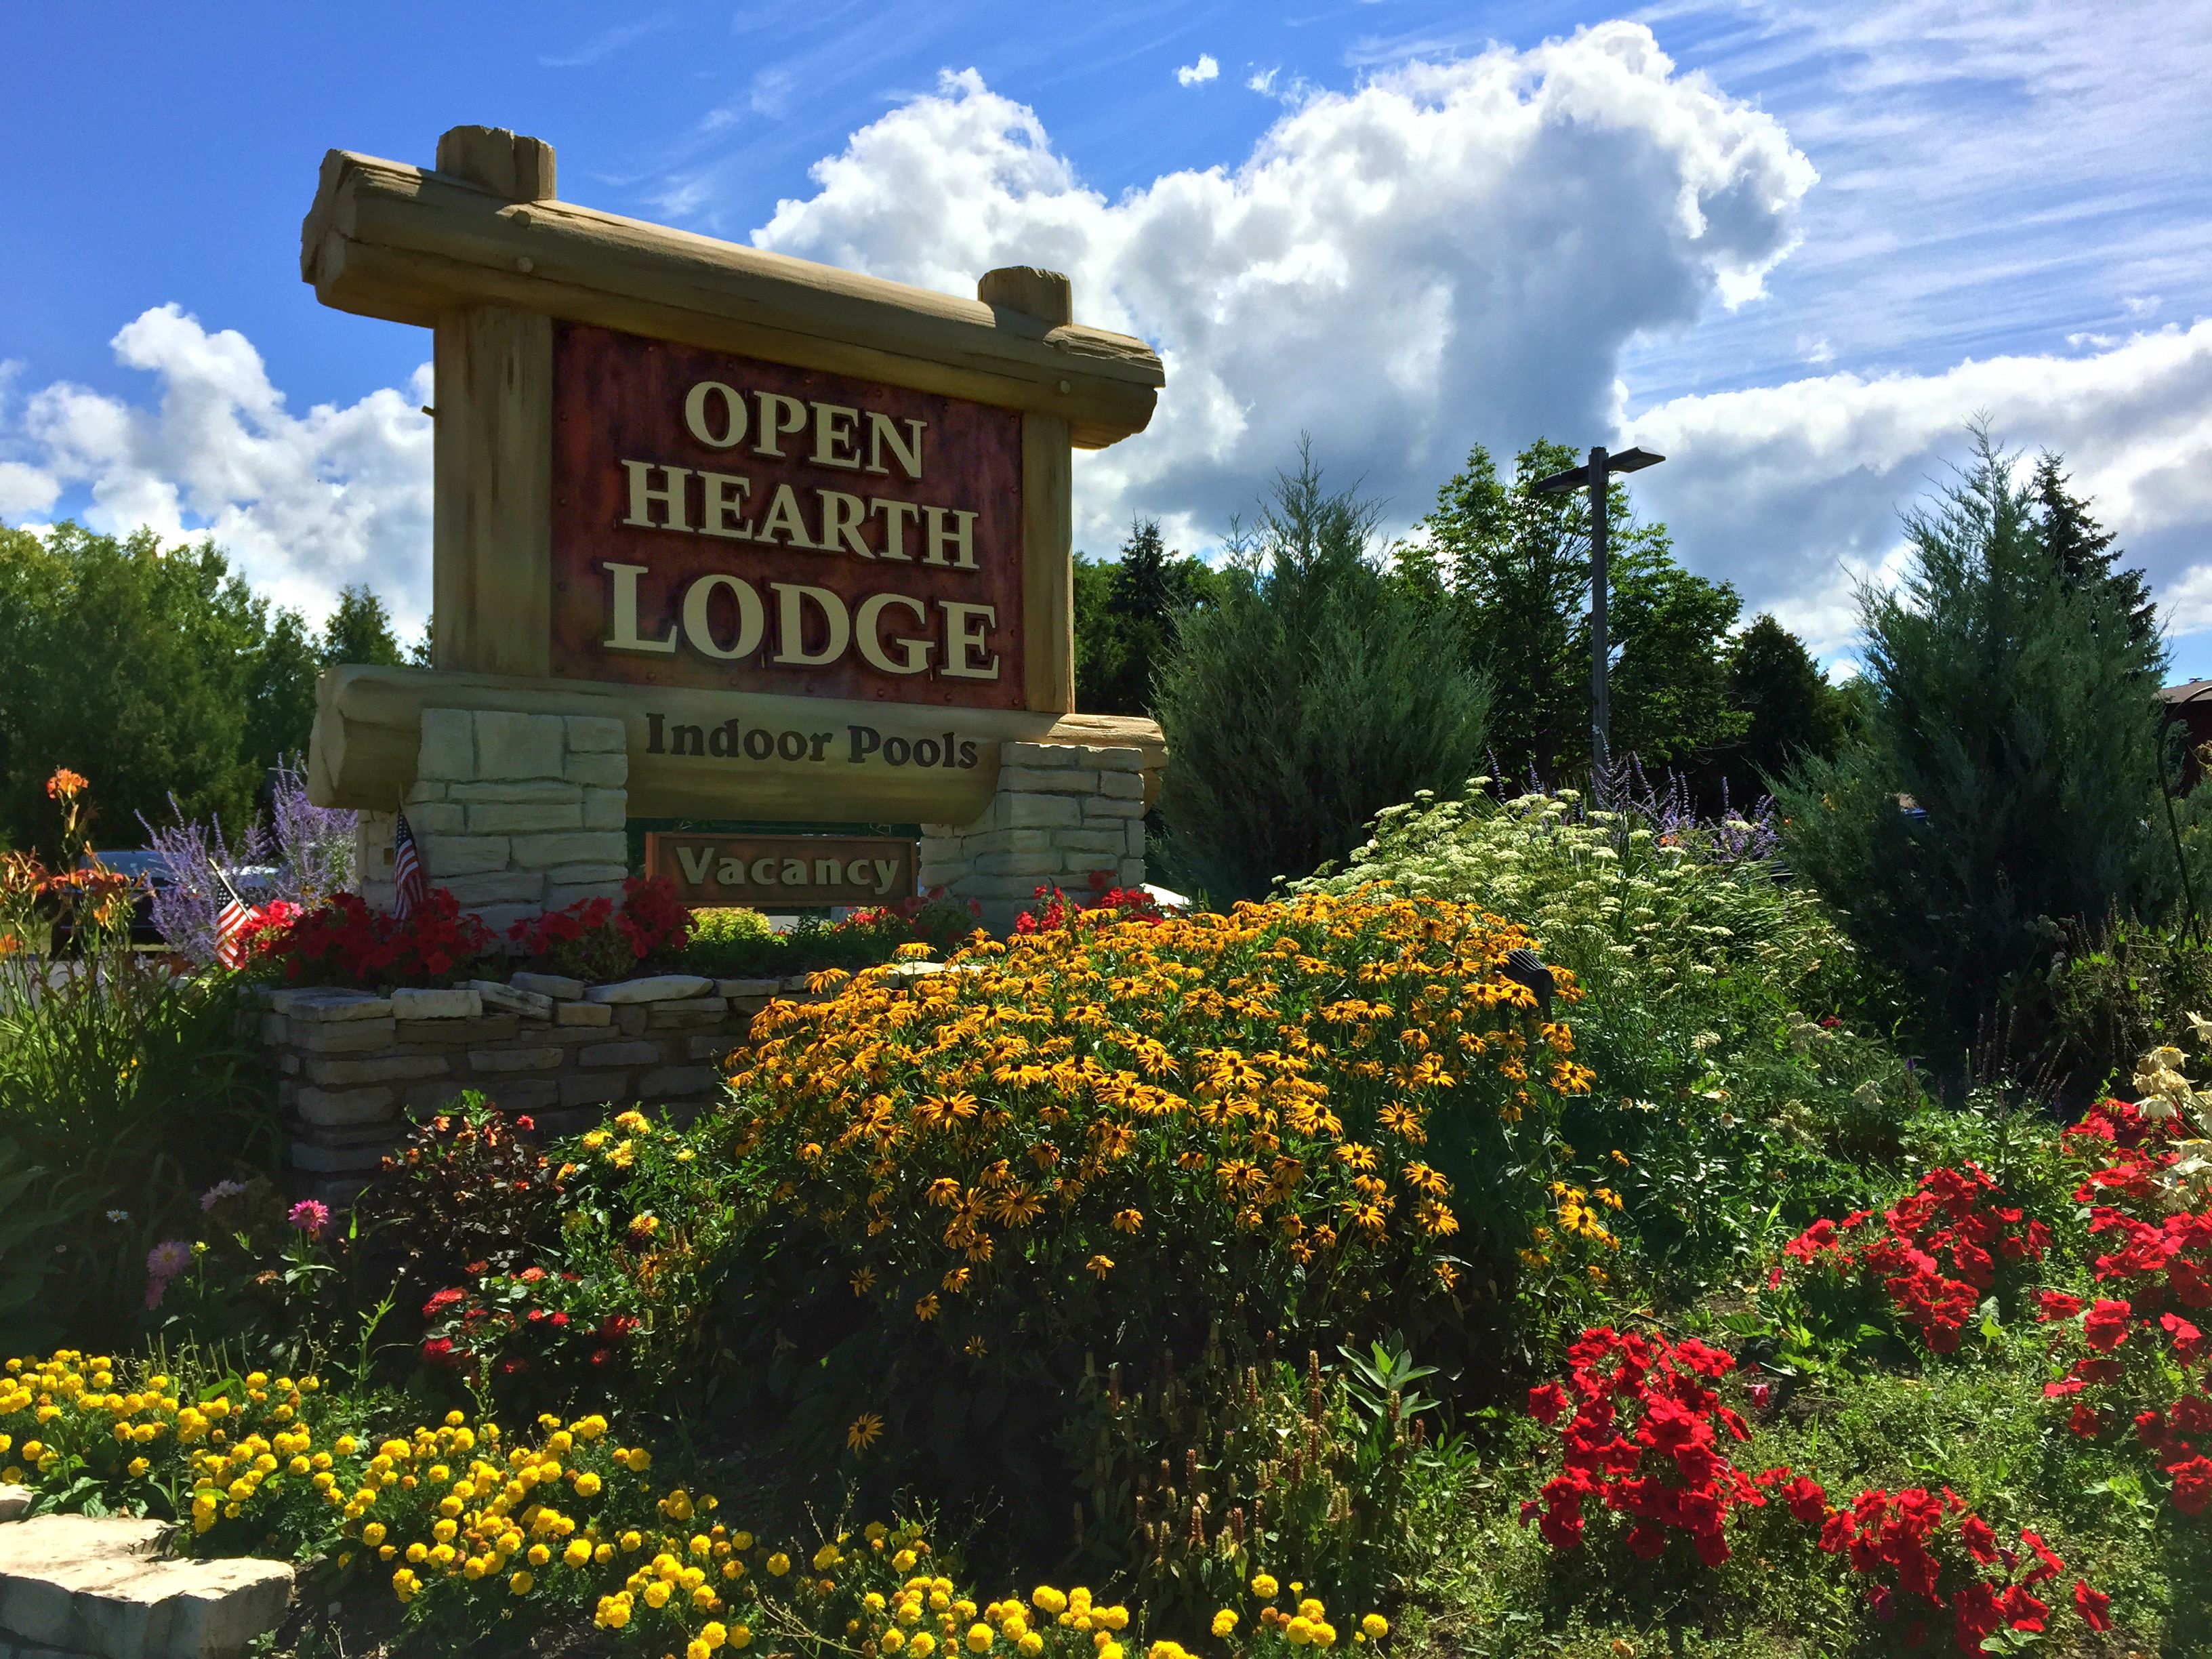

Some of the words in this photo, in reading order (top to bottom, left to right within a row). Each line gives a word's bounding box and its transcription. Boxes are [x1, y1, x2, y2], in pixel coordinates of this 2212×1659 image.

[684, 381, 928, 478] OPEN
[620, 459, 980, 571] HEARTH
[602, 562, 1000, 680] LODGE
[646, 713, 833, 762] Indoor
[848, 725, 978, 769] Pools
[676, 846, 900, 895] Vacancy
